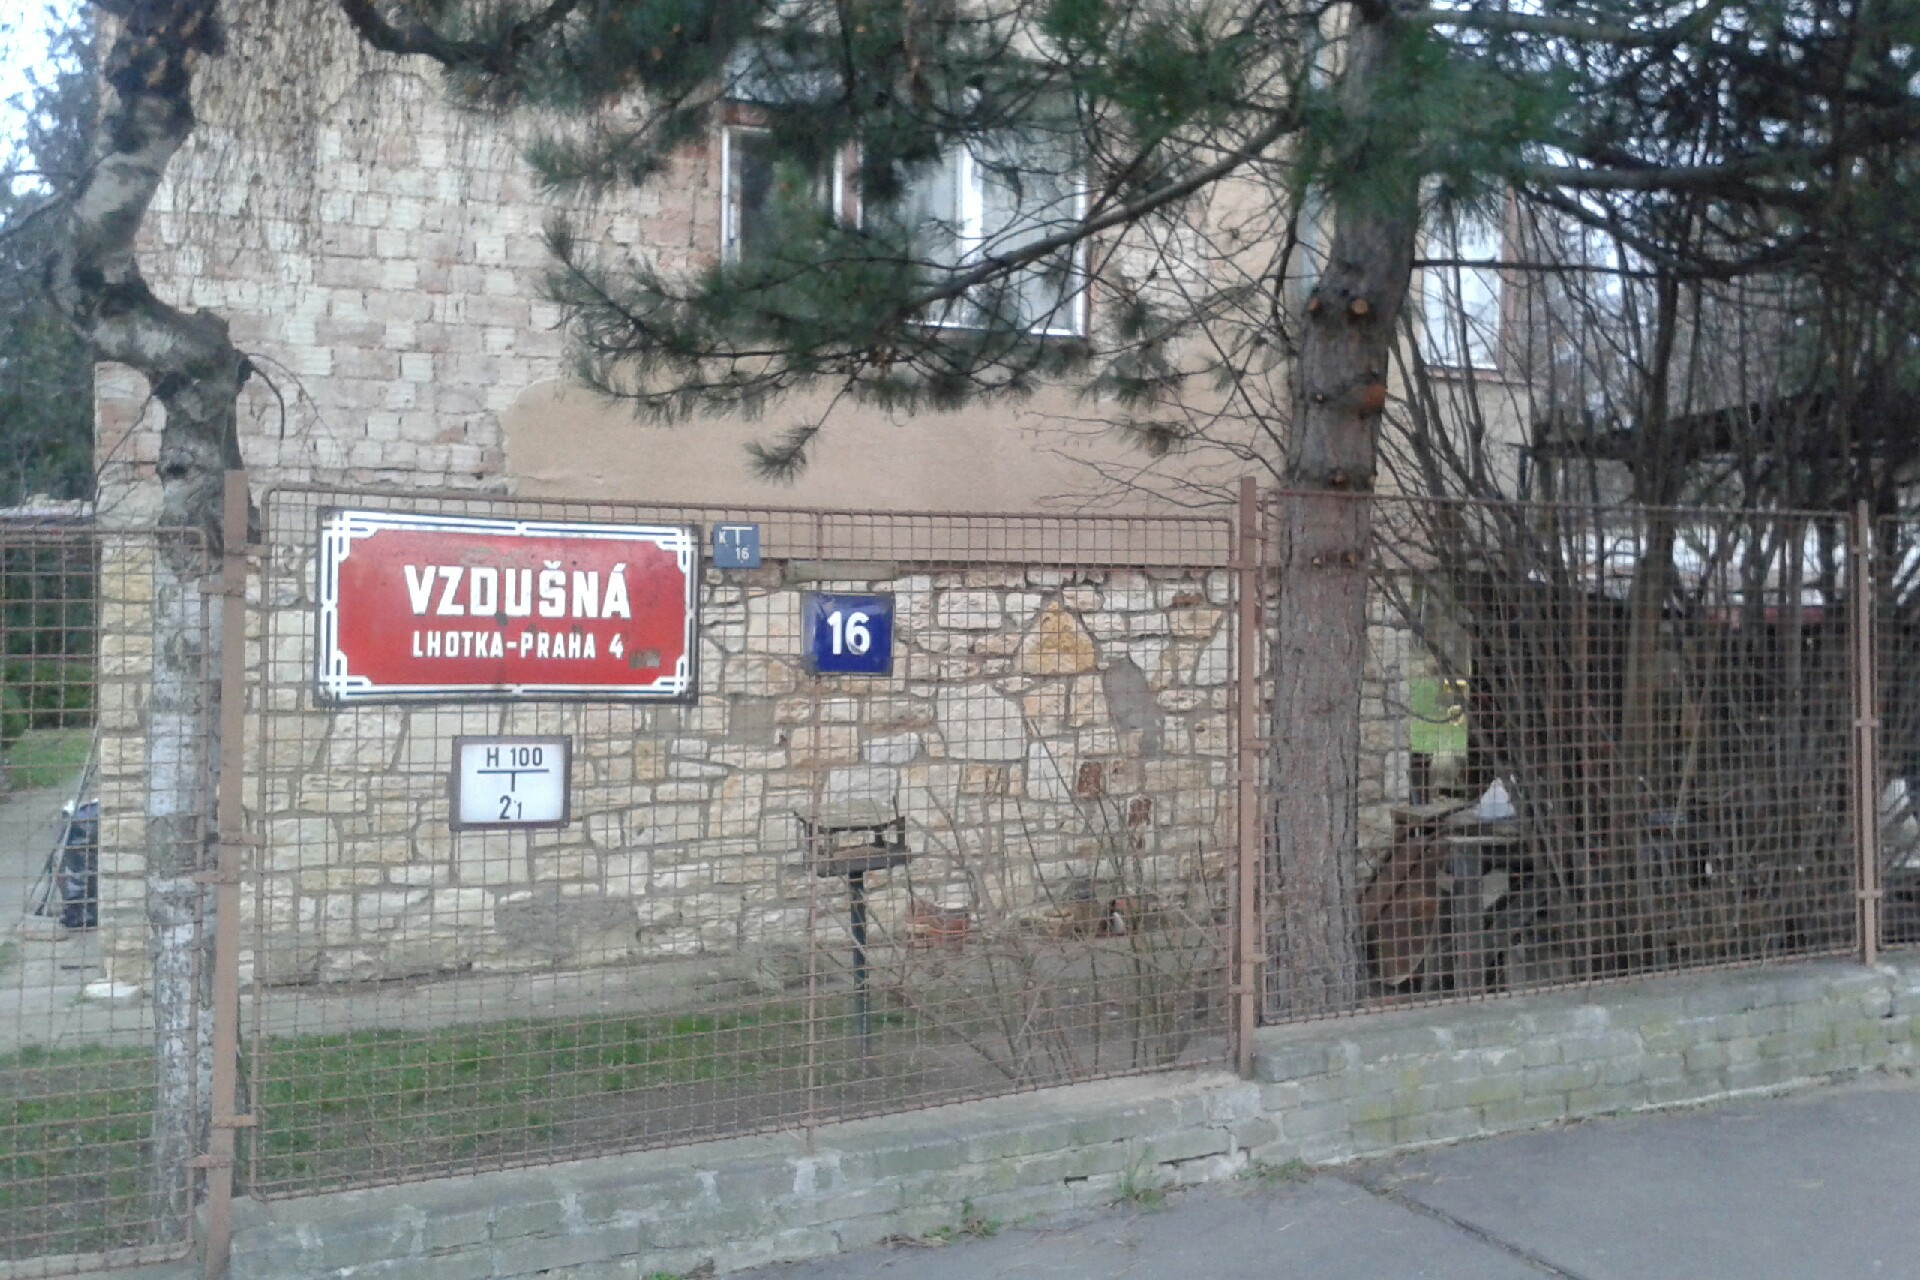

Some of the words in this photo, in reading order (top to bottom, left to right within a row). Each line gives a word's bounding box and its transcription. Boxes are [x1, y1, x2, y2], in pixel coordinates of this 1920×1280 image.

[735, 547, 750, 560] 16
[404, 560, 632, 619] VZDUŠNÁ
[412, 630, 597, 660] LHOTKA-PRAHA
[608, 633, 625, 660] 4
[826, 610, 871, 656] 16
[486, 746, 500, 768] H
[510, 746, 543, 767] 100
